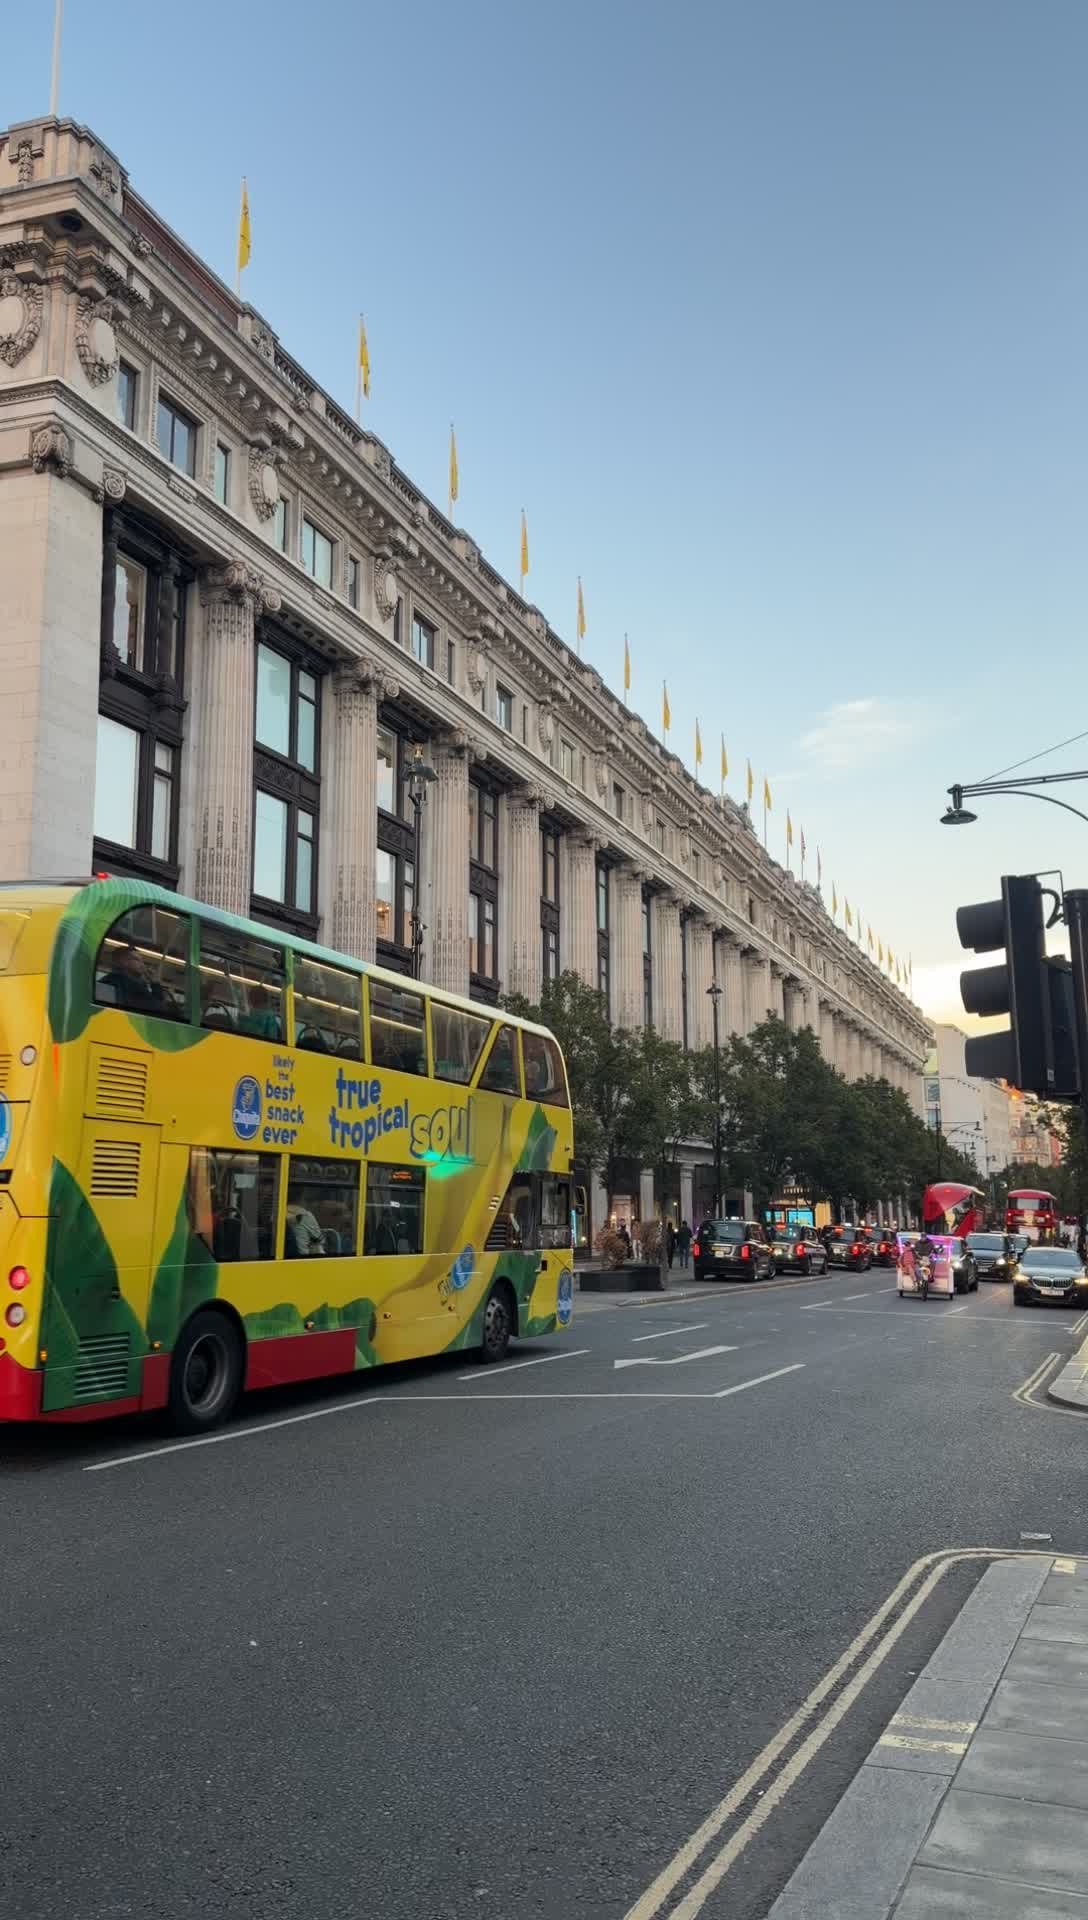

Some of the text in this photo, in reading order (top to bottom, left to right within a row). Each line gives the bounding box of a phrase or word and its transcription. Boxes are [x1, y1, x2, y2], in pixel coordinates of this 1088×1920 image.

[272, 1055, 295, 1072] likely
[278, 1070, 289, 1080] the
[265, 1078, 295, 1102] best
[336, 1067, 381, 1110] true
[267, 1104, 304, 1125] snack
[262, 1125, 298, 1146] ever
[328, 1098, 409, 1155] tropical
